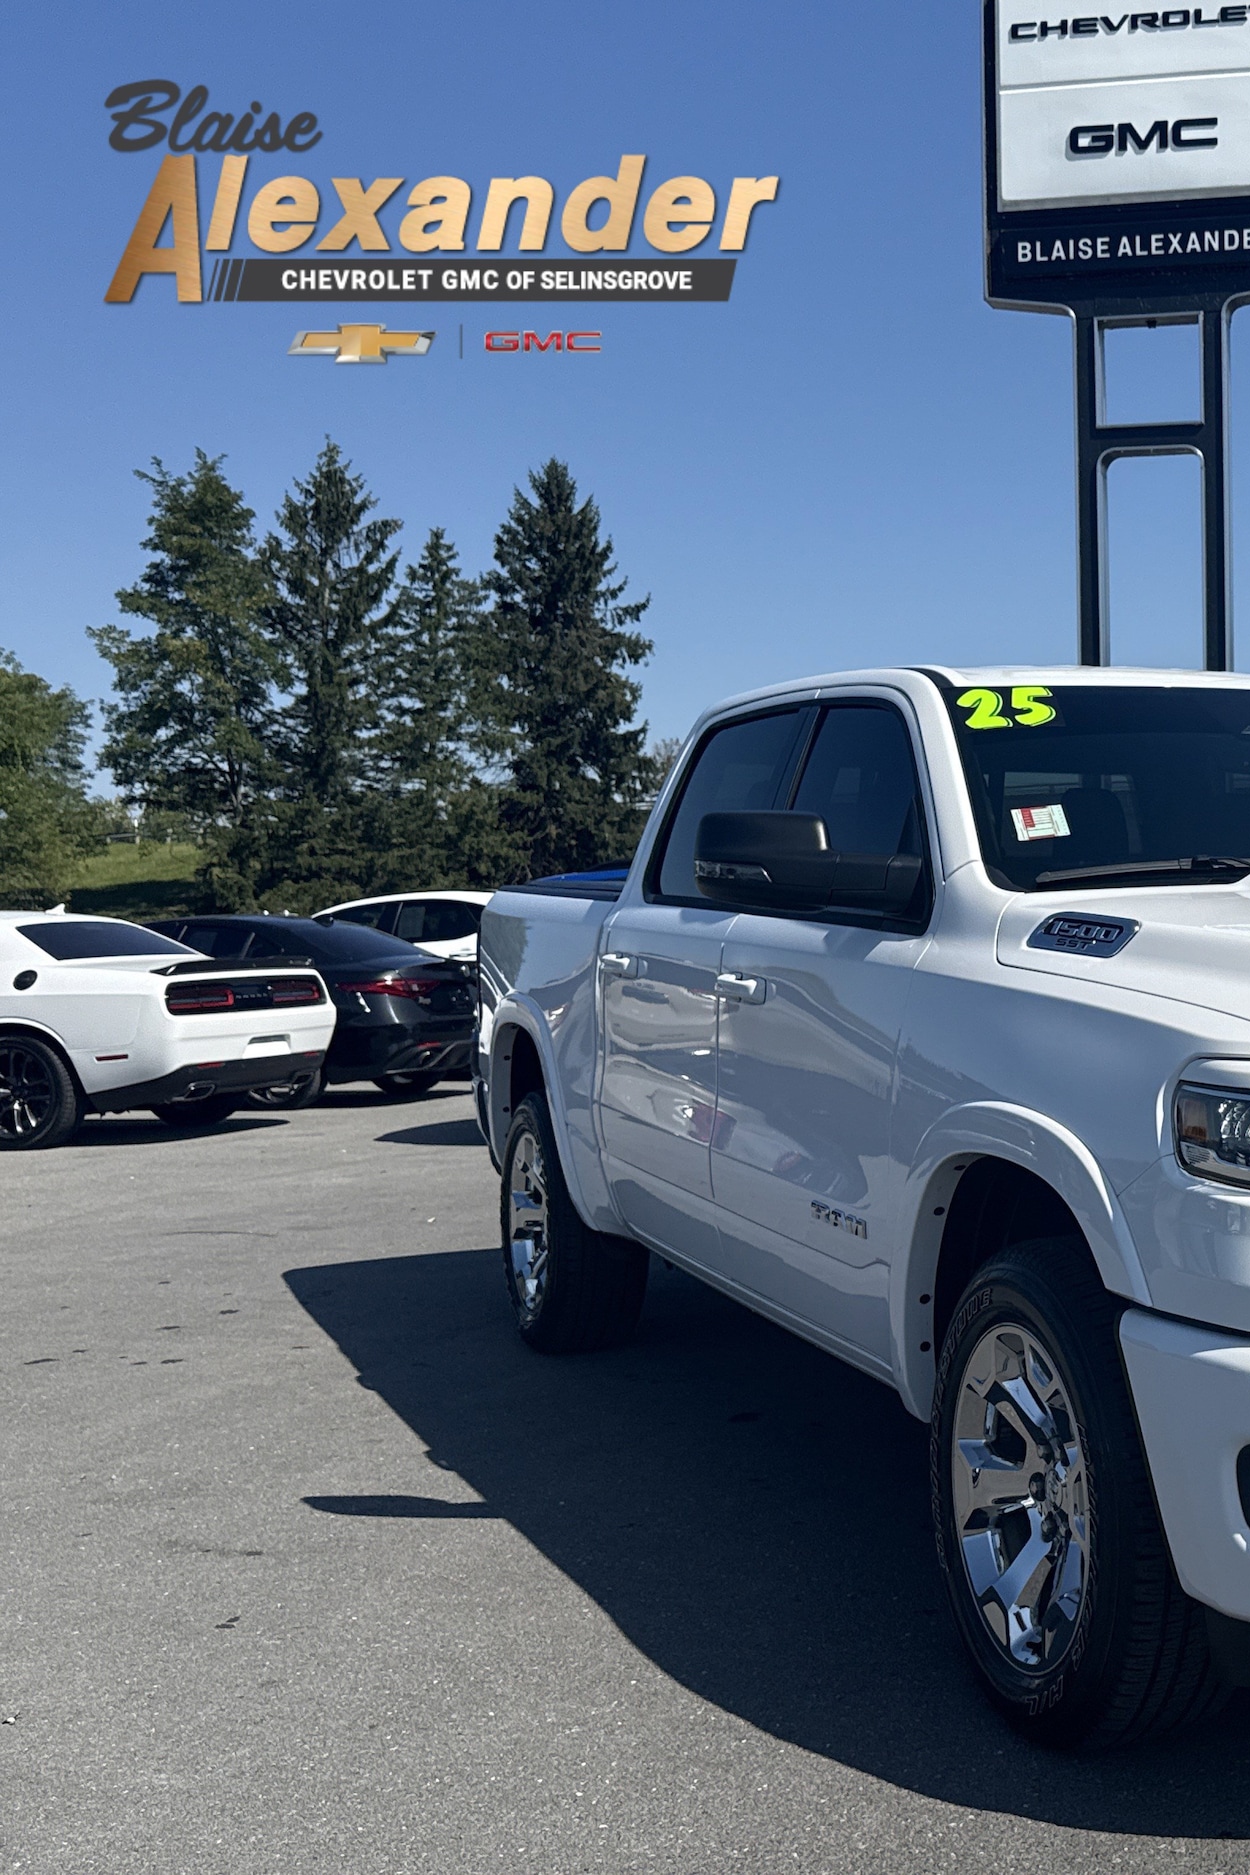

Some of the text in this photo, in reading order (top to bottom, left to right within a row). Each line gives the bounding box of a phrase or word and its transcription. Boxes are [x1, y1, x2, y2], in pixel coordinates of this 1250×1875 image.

[1068, 117, 1218, 157] GMC
[1017, 236, 1111, 263] BLAISE
[956, 686, 1057, 730] 25
[1045, 919, 1121, 942] 1500
[1055, 938, 1094, 951] SST
